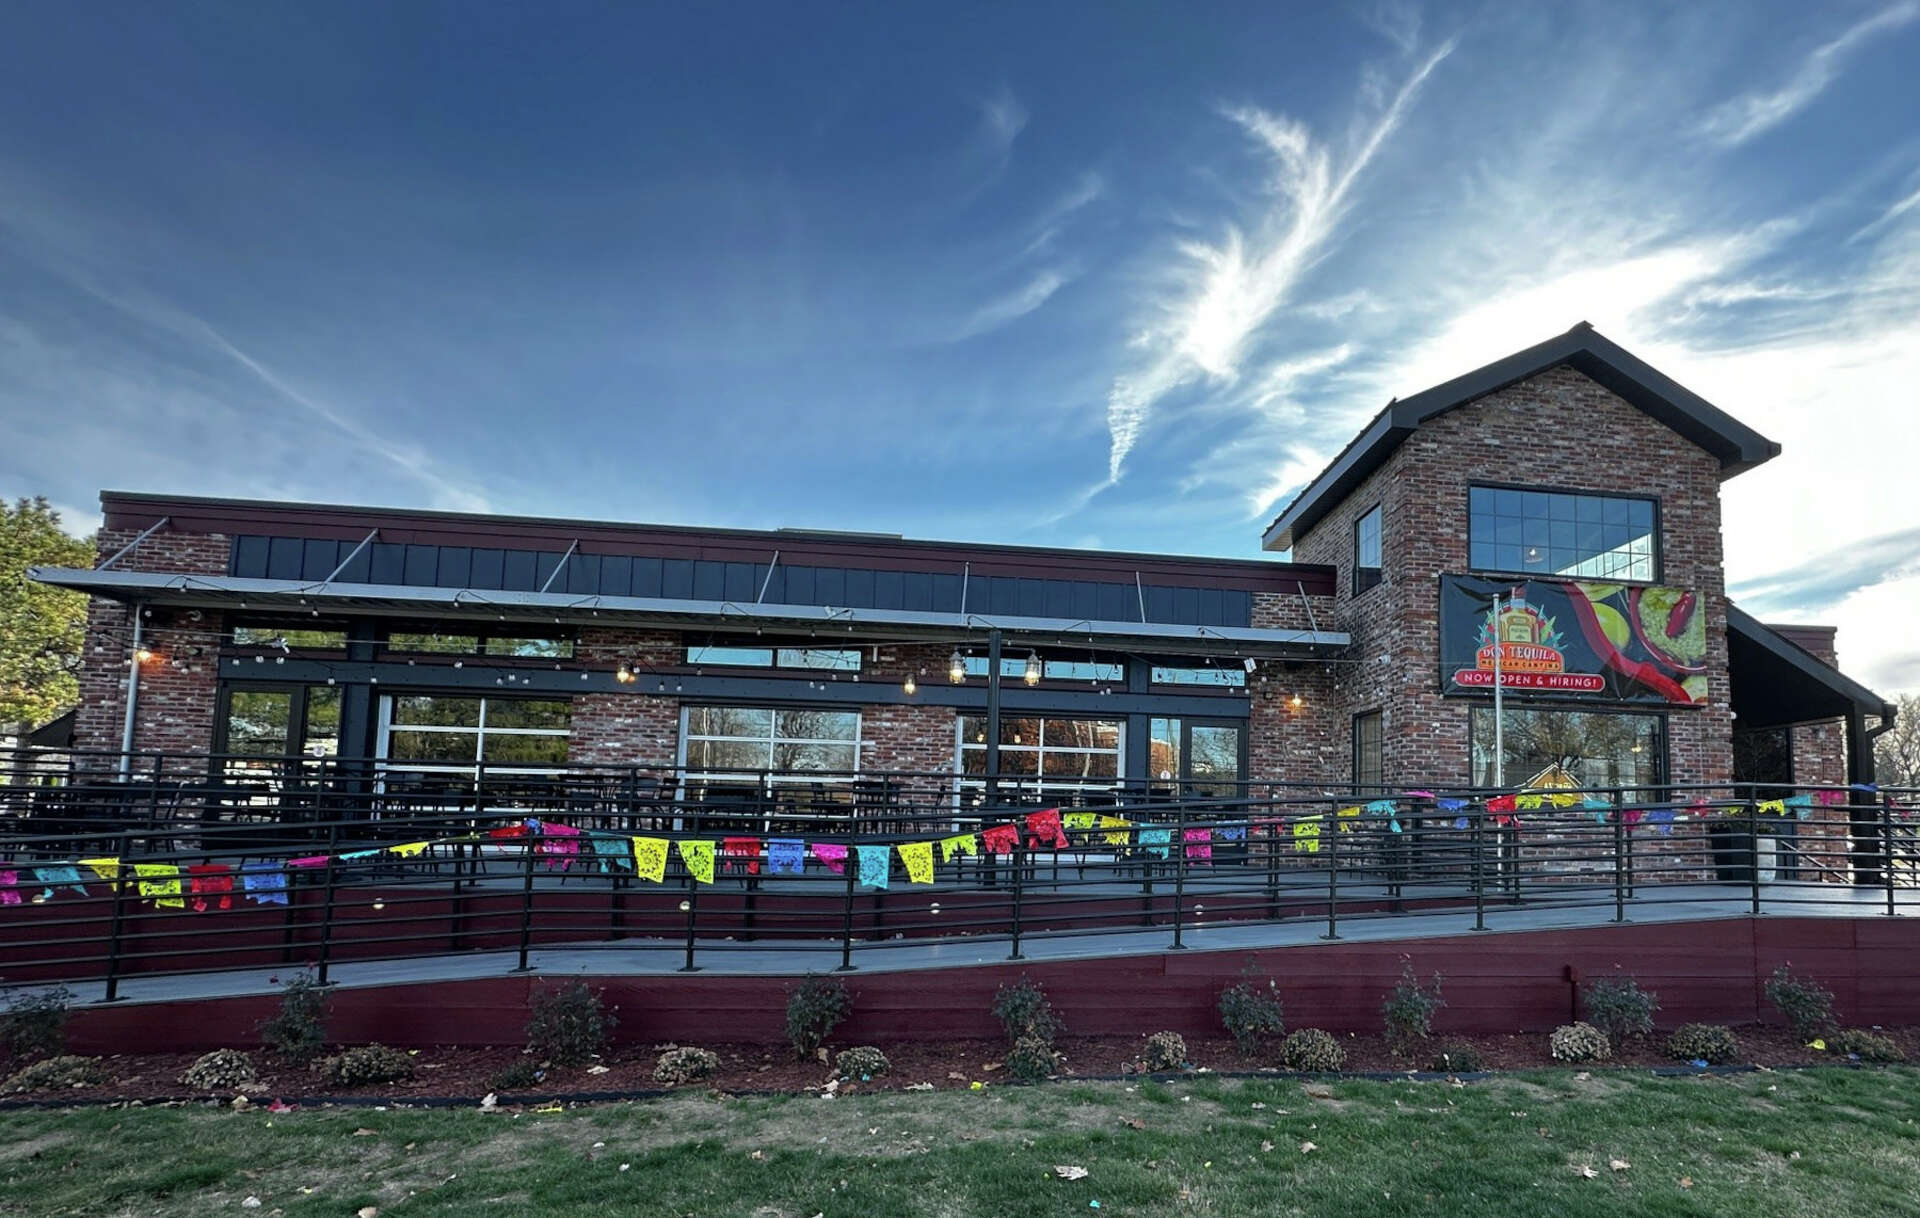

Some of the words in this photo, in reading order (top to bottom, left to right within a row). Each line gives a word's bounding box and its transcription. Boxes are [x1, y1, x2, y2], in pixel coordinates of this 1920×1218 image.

[1483, 646, 1505, 658] DON
[1509, 646, 1556, 661] TEQUILA
[1481, 659, 1519, 667] MECAN
[1522, 661, 1559, 669] CANTINA
[1464, 673, 1493, 683] NOW
[1498, 674, 1531, 685] OPEN
[1536, 676, 1544, 686] &
[1550, 676, 1597, 688] HIRING!
